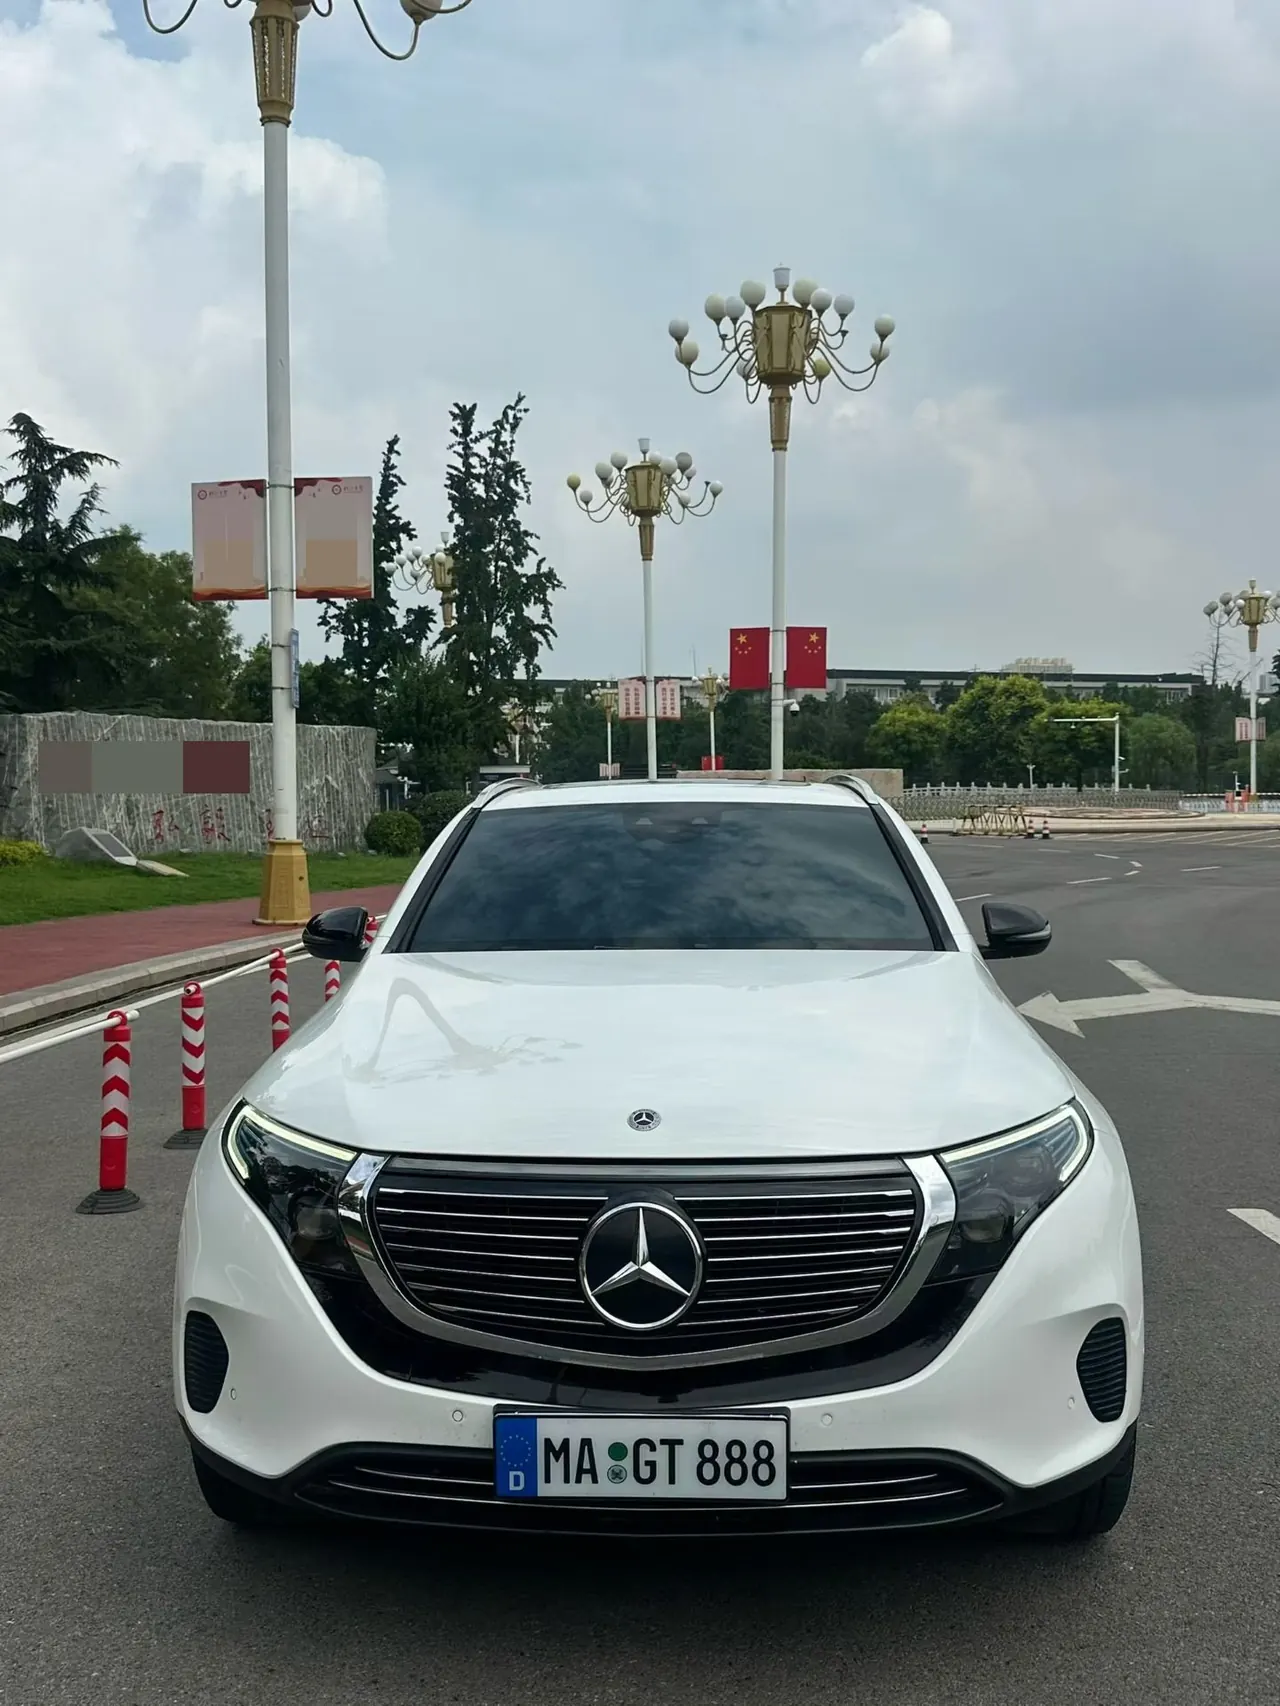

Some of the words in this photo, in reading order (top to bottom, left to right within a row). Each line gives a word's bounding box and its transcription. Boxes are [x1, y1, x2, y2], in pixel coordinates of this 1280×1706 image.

[543, 1437, 599, 1485] MA
[632, 1438, 684, 1485] GT
[696, 1438, 777, 1487] 888
[508, 1470, 525, 1491] D
